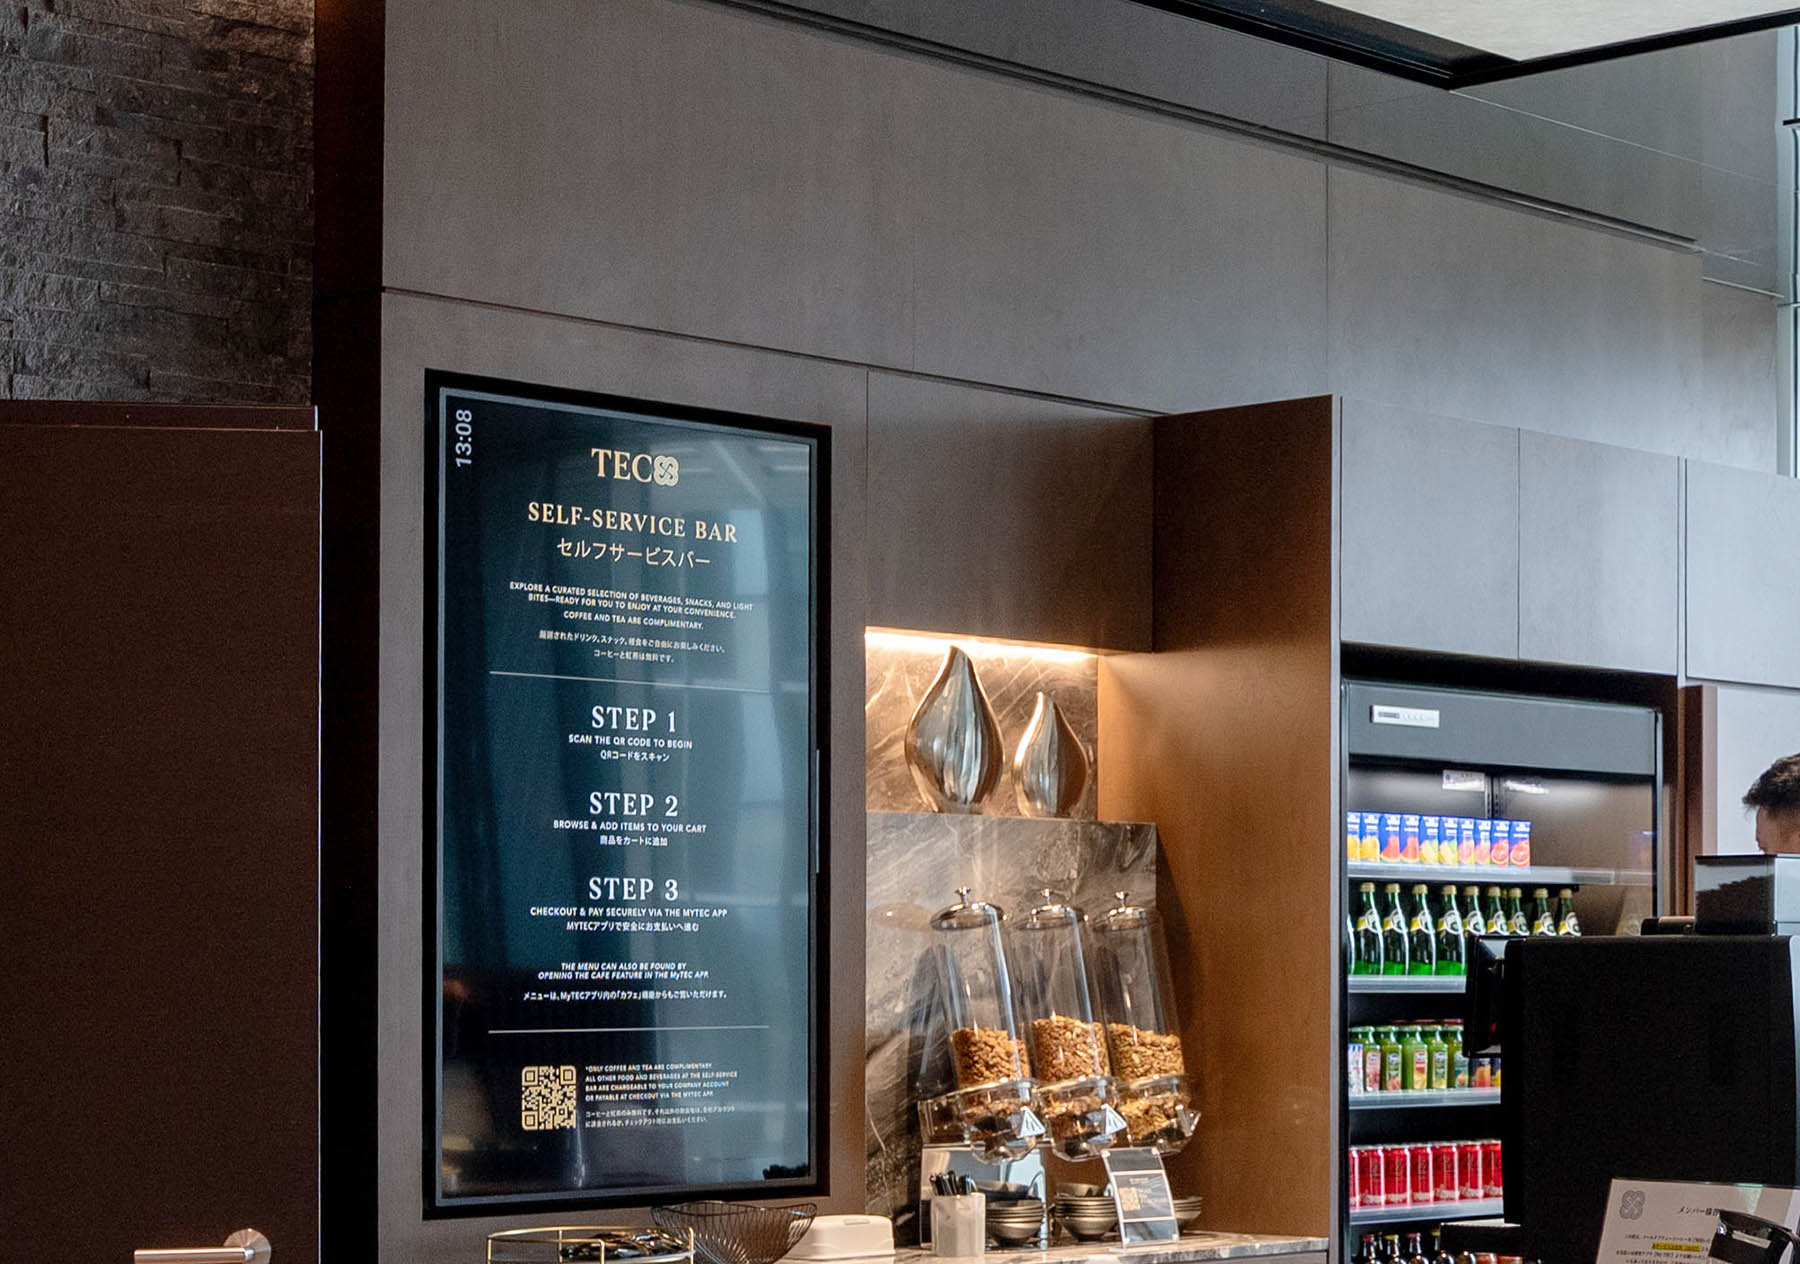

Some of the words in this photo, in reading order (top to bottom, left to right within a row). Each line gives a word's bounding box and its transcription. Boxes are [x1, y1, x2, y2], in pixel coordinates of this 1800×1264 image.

[456, 409, 472, 467] 13:08
[528, 502, 685, 537] SELF-SERVICE
[696, 521, 737, 542] BAR
[557, 538, 710, 568] セルフサービスバー
[509, 581, 543, 592] EXPLORE
[545, 585, 551, 593] A
[552, 585, 585, 596] CURATED
[587, 588, 627, 600] SELECTION
[629, 592, 639, 600] OF
[640, 593, 683, 605] BEVERAGES,
[685, 597, 714, 608] SNACKS,
[716, 601, 731, 610] AND
[733, 602, 753, 611] LIGHT
[581, 598, 596, 606] FOR
[597, 599, 613, 608] YOU
[615, 601, 625, 609] TO
[627, 602, 651, 611] ENJOY
[653, 604, 661, 612] AT
[663, 605, 682, 614] YOUR
[684, 607, 736, 619] CONVENIENCE.
[563, 611, 592, 620] COFFEE
[594, 613, 610, 622] AND
[612, 615, 626, 623] TEA
[628, 616, 641, 625] ARE
[643, 618, 704, 630] COMPLIMENTARY.
[592, 706, 656, 731] STEP
[668, 711, 675, 732] 1
[569, 734, 592, 744] SCAN
[595, 735, 611, 744] THE
[613, 737, 625, 746] QR
[628, 737, 651, 747] CODE
[654, 739, 665, 747] TO
[667, 740, 693, 749] BEGIN
[600, 750, 670, 762] QRコードをスキャン
[589, 792, 654, 816] STEP
[665, 795, 678, 817] 2
[553, 820, 589, 830] BROWSE
[591, 821, 597, 830] &
[600, 821, 618, 830] ADD
[620, 822, 645, 831] ITEMS
[647, 823, 659, 831] TO
[661, 824, 683, 832] YOUR
[686, 824, 707, 833] CART
[600, 835, 667, 846] 商品をカートに追加
[588, 877, 654, 900] STEP
[665, 879, 679, 901] 3
[530, 907, 577, 916] CHECKOUT
[579, 907, 586, 916] &
[588, 907, 603, 917] PAY
[606, 908, 646, 917] SECURELY
[648, 908, 662, 917] VIA
[664, 908, 680, 917] THE
[682, 908, 709, 917] MYTEC
[712, 909, 728, 917] APP
[538, 971, 573, 980] OPENING
[574, 971, 589, 980] THE
[612, 971, 643, 979] FEATURE
[644, 971, 652, 979] IN
[654, 971, 668, 979] THE
[670, 971, 692, 981] MyTEC
[561, 962, 576, 970] THE
[577, 962, 599, 970] MENU
[601, 962, 617, 970] CAN
[618, 962, 637, 970] ALSO
[639, 962, 649, 970] BE
[650, 962, 676, 970] FOUND
[677, 962, 687, 970] BY
